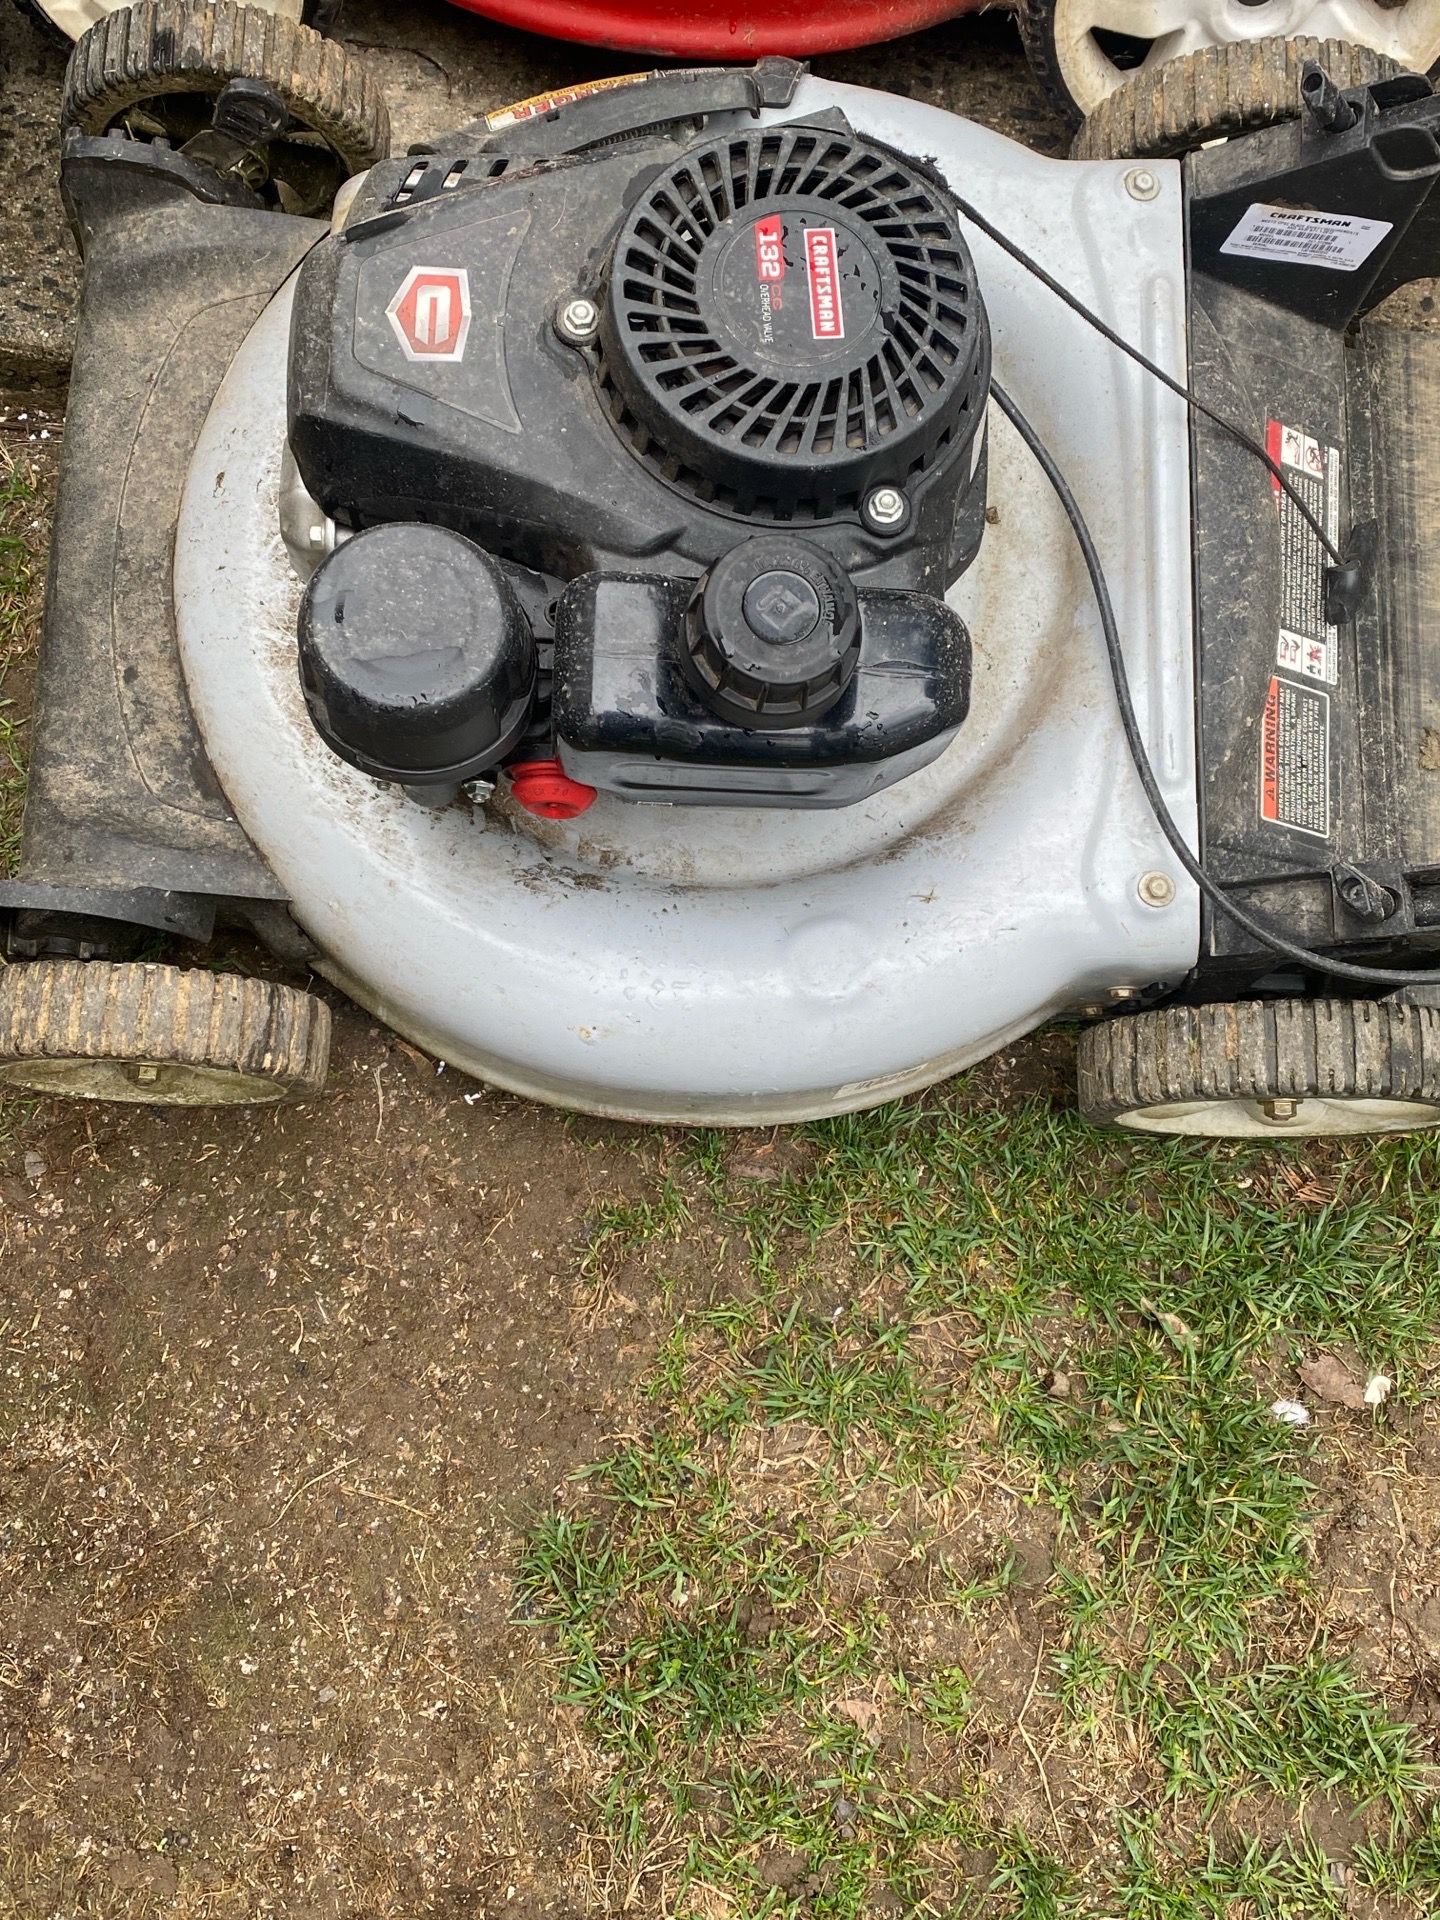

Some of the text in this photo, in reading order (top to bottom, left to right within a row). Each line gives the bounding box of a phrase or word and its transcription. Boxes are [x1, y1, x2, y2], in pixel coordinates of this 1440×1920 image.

[1270, 212, 1351, 227] CRAFTSMAN
[759, 232, 782, 277] 132
[812, 235, 836, 332] CRAFTSMAN
[759, 284, 774, 343] OVERHEAD VALVE
[1281, 511, 1286, 523] OR
[1309, 698, 1313, 709] OR
[1314, 720, 1319, 730] TO
[1265, 695, 1276, 782] WARNING
[1296, 756, 1301, 766] BE
[1279, 765, 1284, 775] OF
